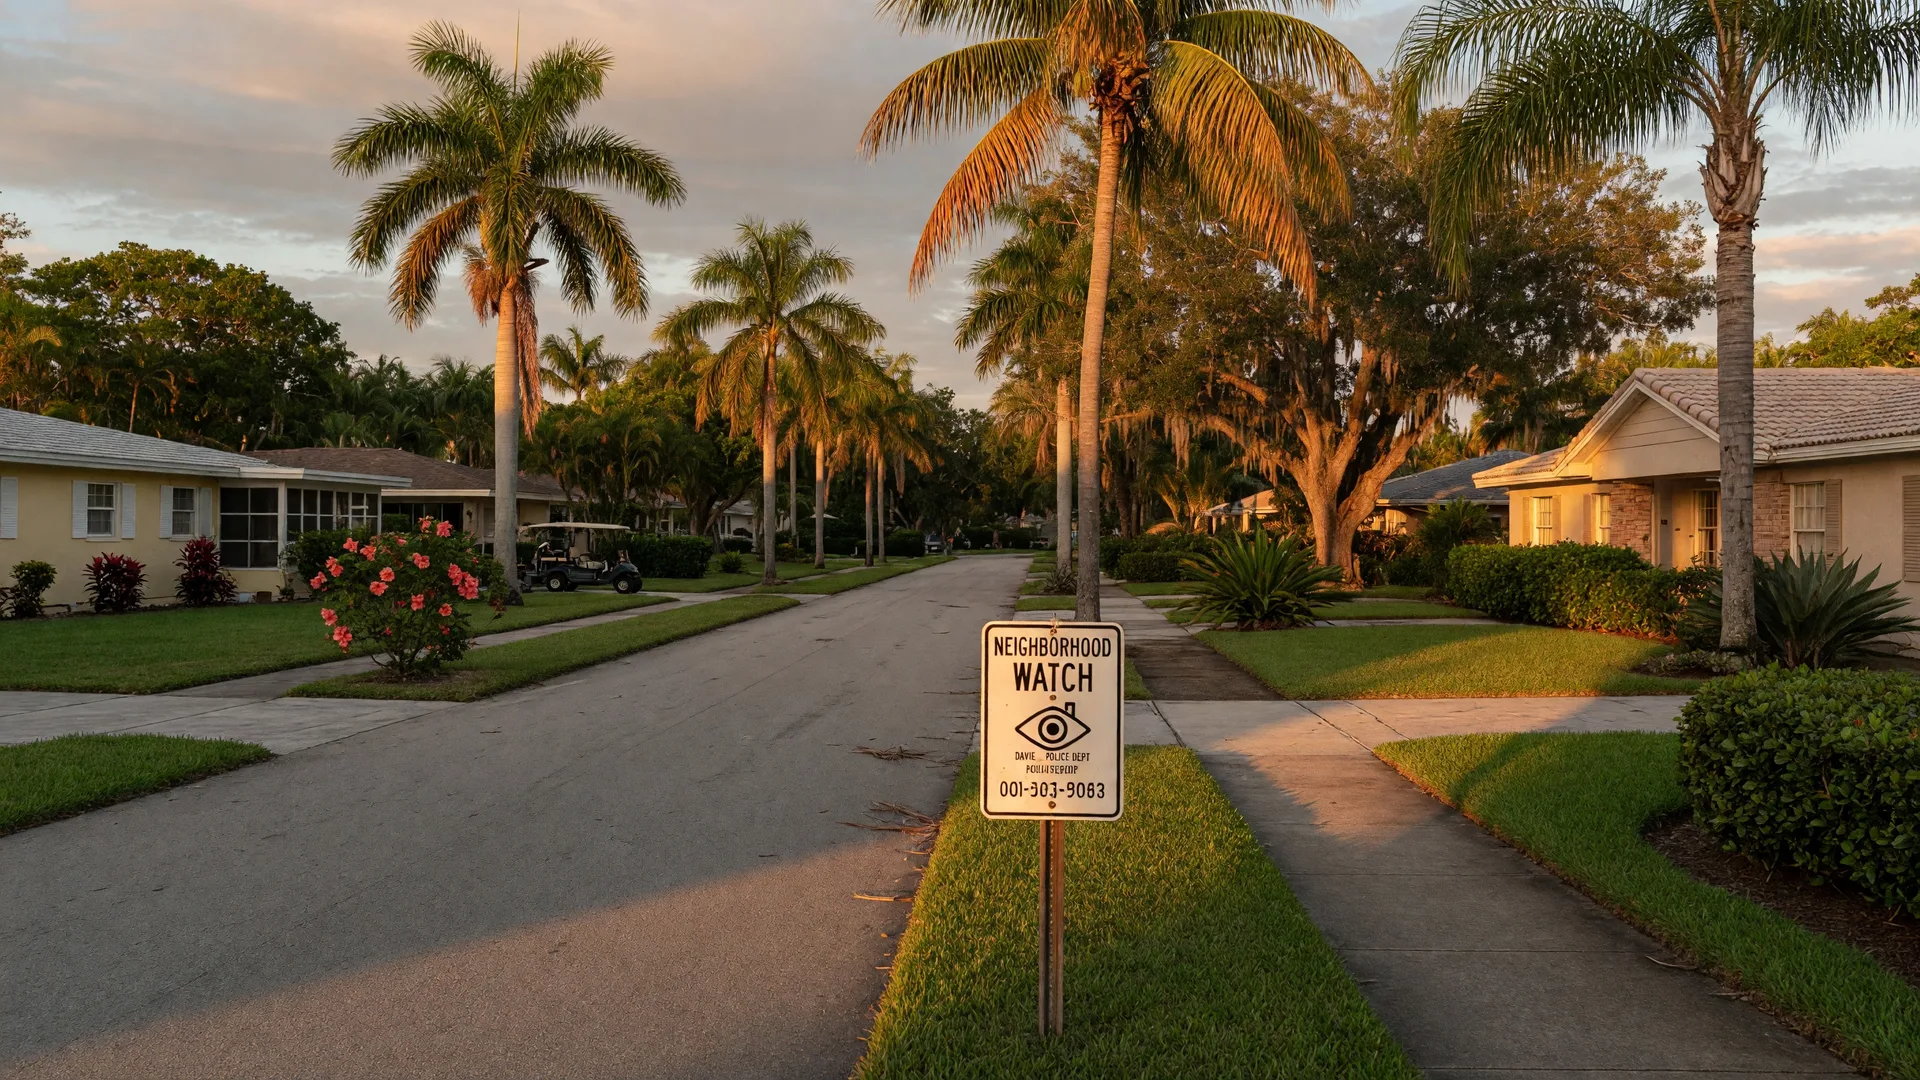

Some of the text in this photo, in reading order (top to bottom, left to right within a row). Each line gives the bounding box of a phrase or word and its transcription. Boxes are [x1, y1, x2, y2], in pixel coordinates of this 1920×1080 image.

[994, 636, 1111, 657] NEIGHBORHOOD
[1013, 662, 1093, 692] WATCH
[1015, 751, 1090, 762] DAVIE POLICE DEPT
